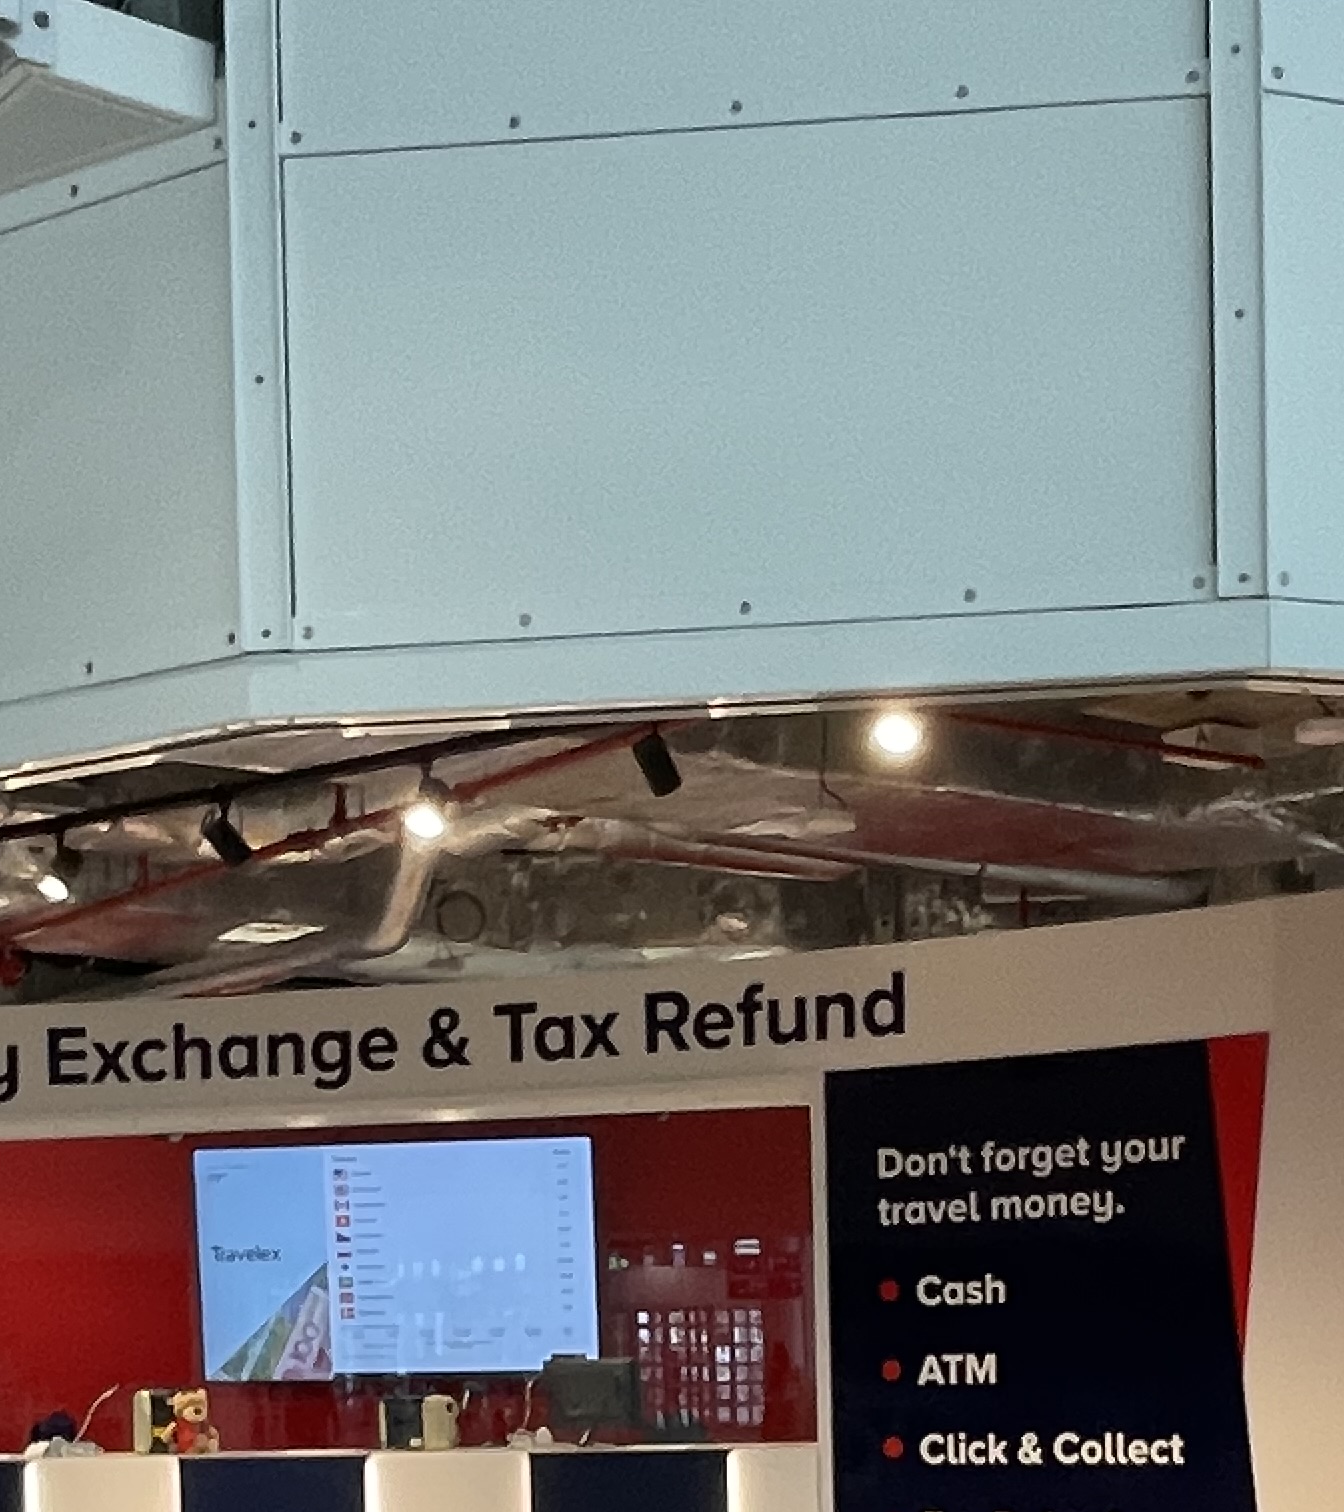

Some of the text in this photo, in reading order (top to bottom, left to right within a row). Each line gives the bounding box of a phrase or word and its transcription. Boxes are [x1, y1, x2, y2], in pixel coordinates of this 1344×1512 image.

[47, 1022, 398, 1090] Exchange
[423, 1007, 471, 1067] &
[494, 1002, 619, 1062] Tax
[645, 971, 906, 1053] Refund
[877, 1135, 1185, 1178] Don't forget your
[878, 1190, 1126, 1225] travel money.
[211, 1244, 282, 1262] Travelex
[916, 1273, 1007, 1306] Cash
[917, 1353, 997, 1386] ATM
[919, 1431, 1185, 1465] Click & Collect
